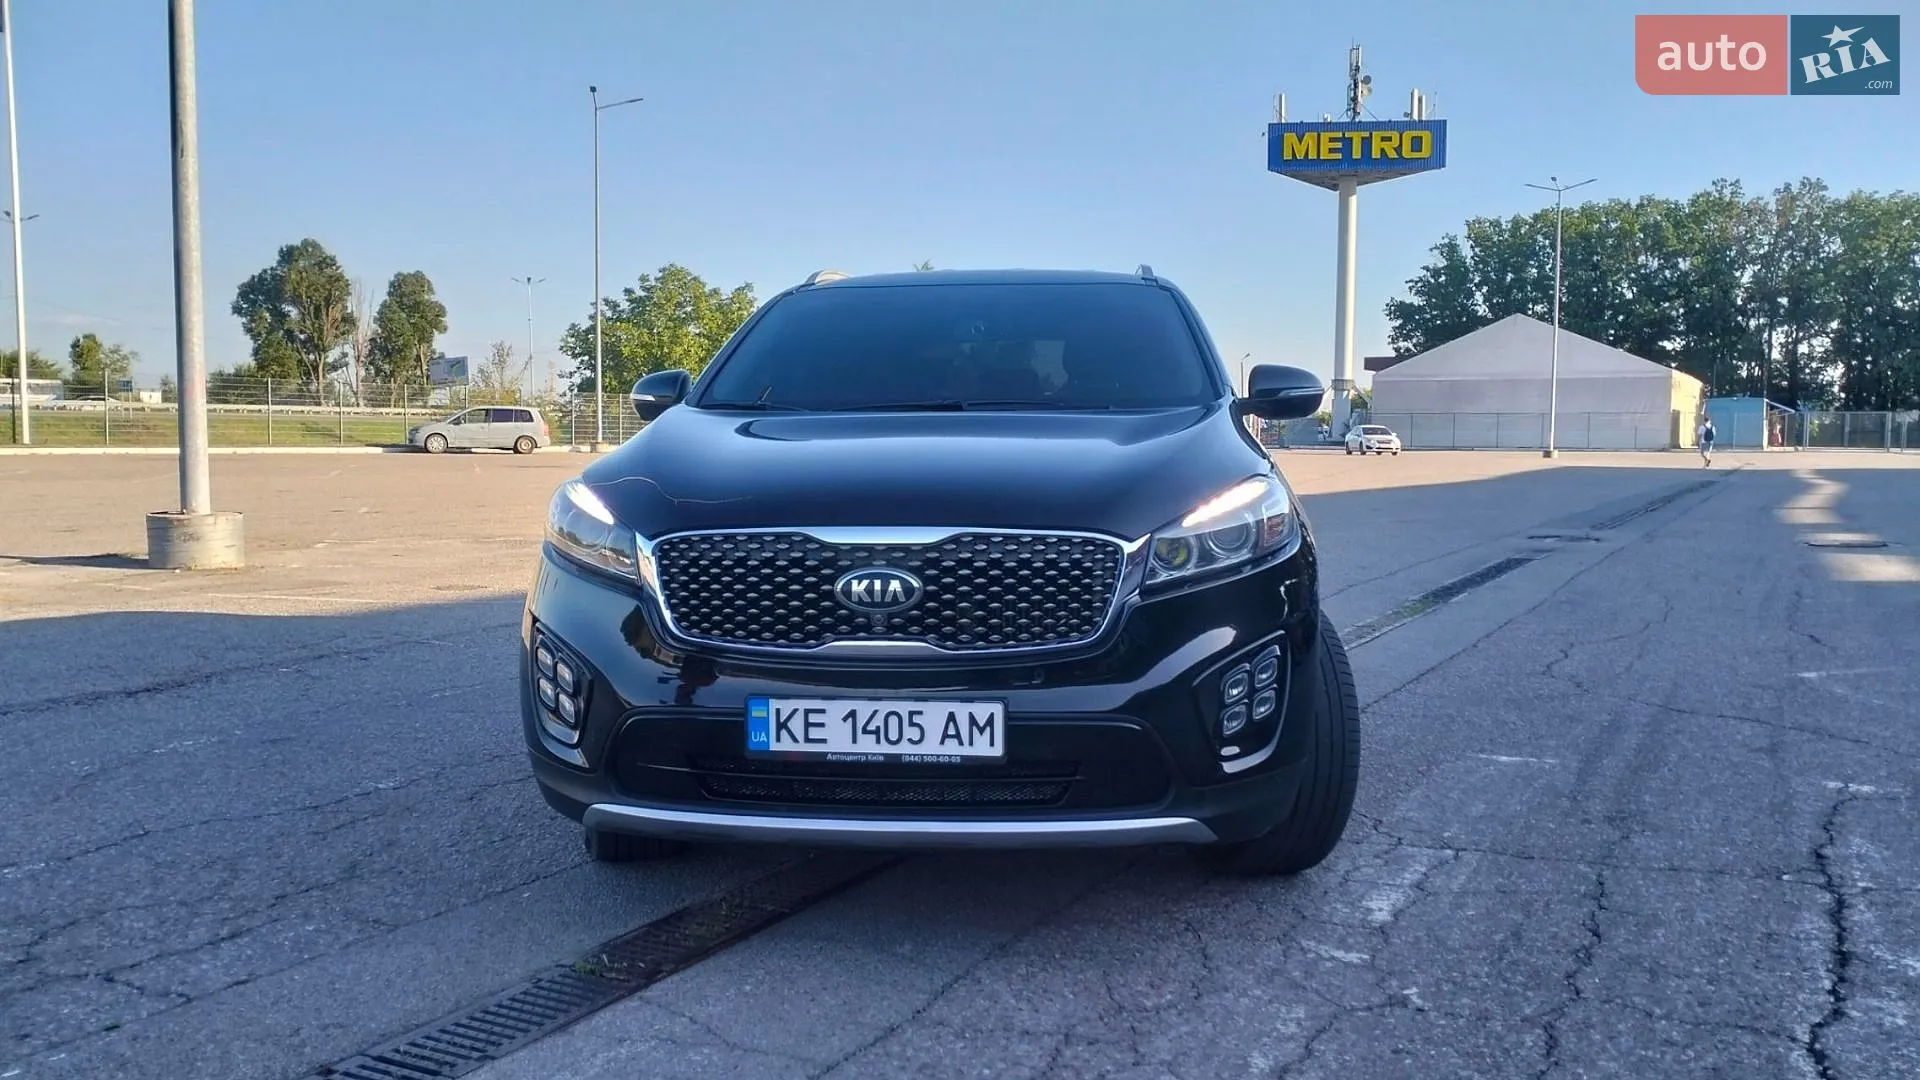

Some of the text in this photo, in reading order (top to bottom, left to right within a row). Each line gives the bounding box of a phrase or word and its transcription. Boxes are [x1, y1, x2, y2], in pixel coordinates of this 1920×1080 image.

[1283, 130, 1432, 160] METRO
[850, 579, 906, 602] KIA
[752, 731, 768, 742] UA
[774, 708, 995, 747] KE 1405 AM
